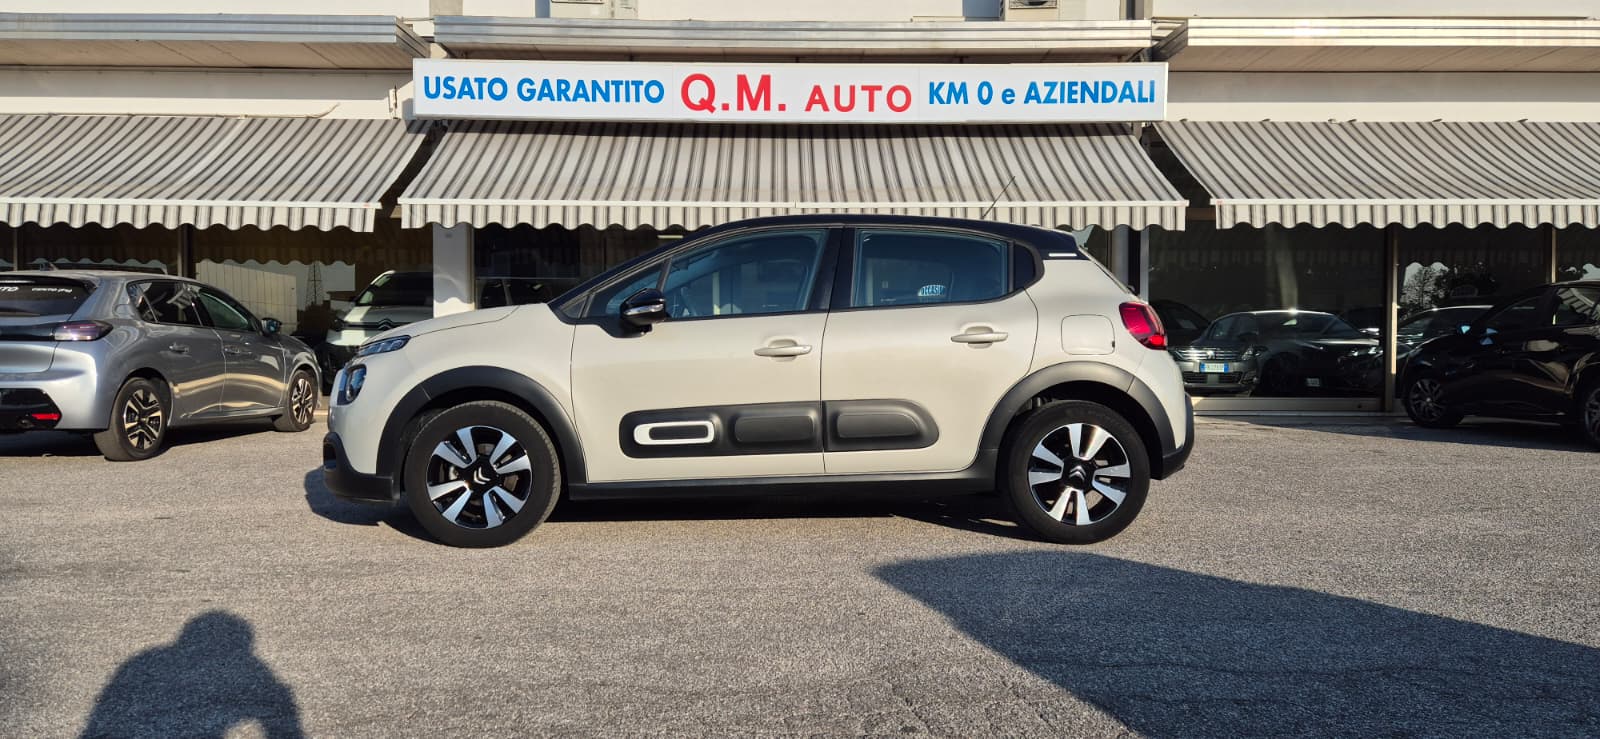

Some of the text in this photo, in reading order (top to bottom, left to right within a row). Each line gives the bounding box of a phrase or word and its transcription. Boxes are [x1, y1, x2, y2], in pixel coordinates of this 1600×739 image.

[424, 76, 508, 101] USATO
[517, 78, 665, 104] GARANTITO
[681, 73, 786, 113] Q.M.
[805, 84, 911, 112] AUTO
[929, 82, 968, 104] KM
[1001, 87, 1015, 104] e
[1024, 80, 1155, 104] AZIENDALI
